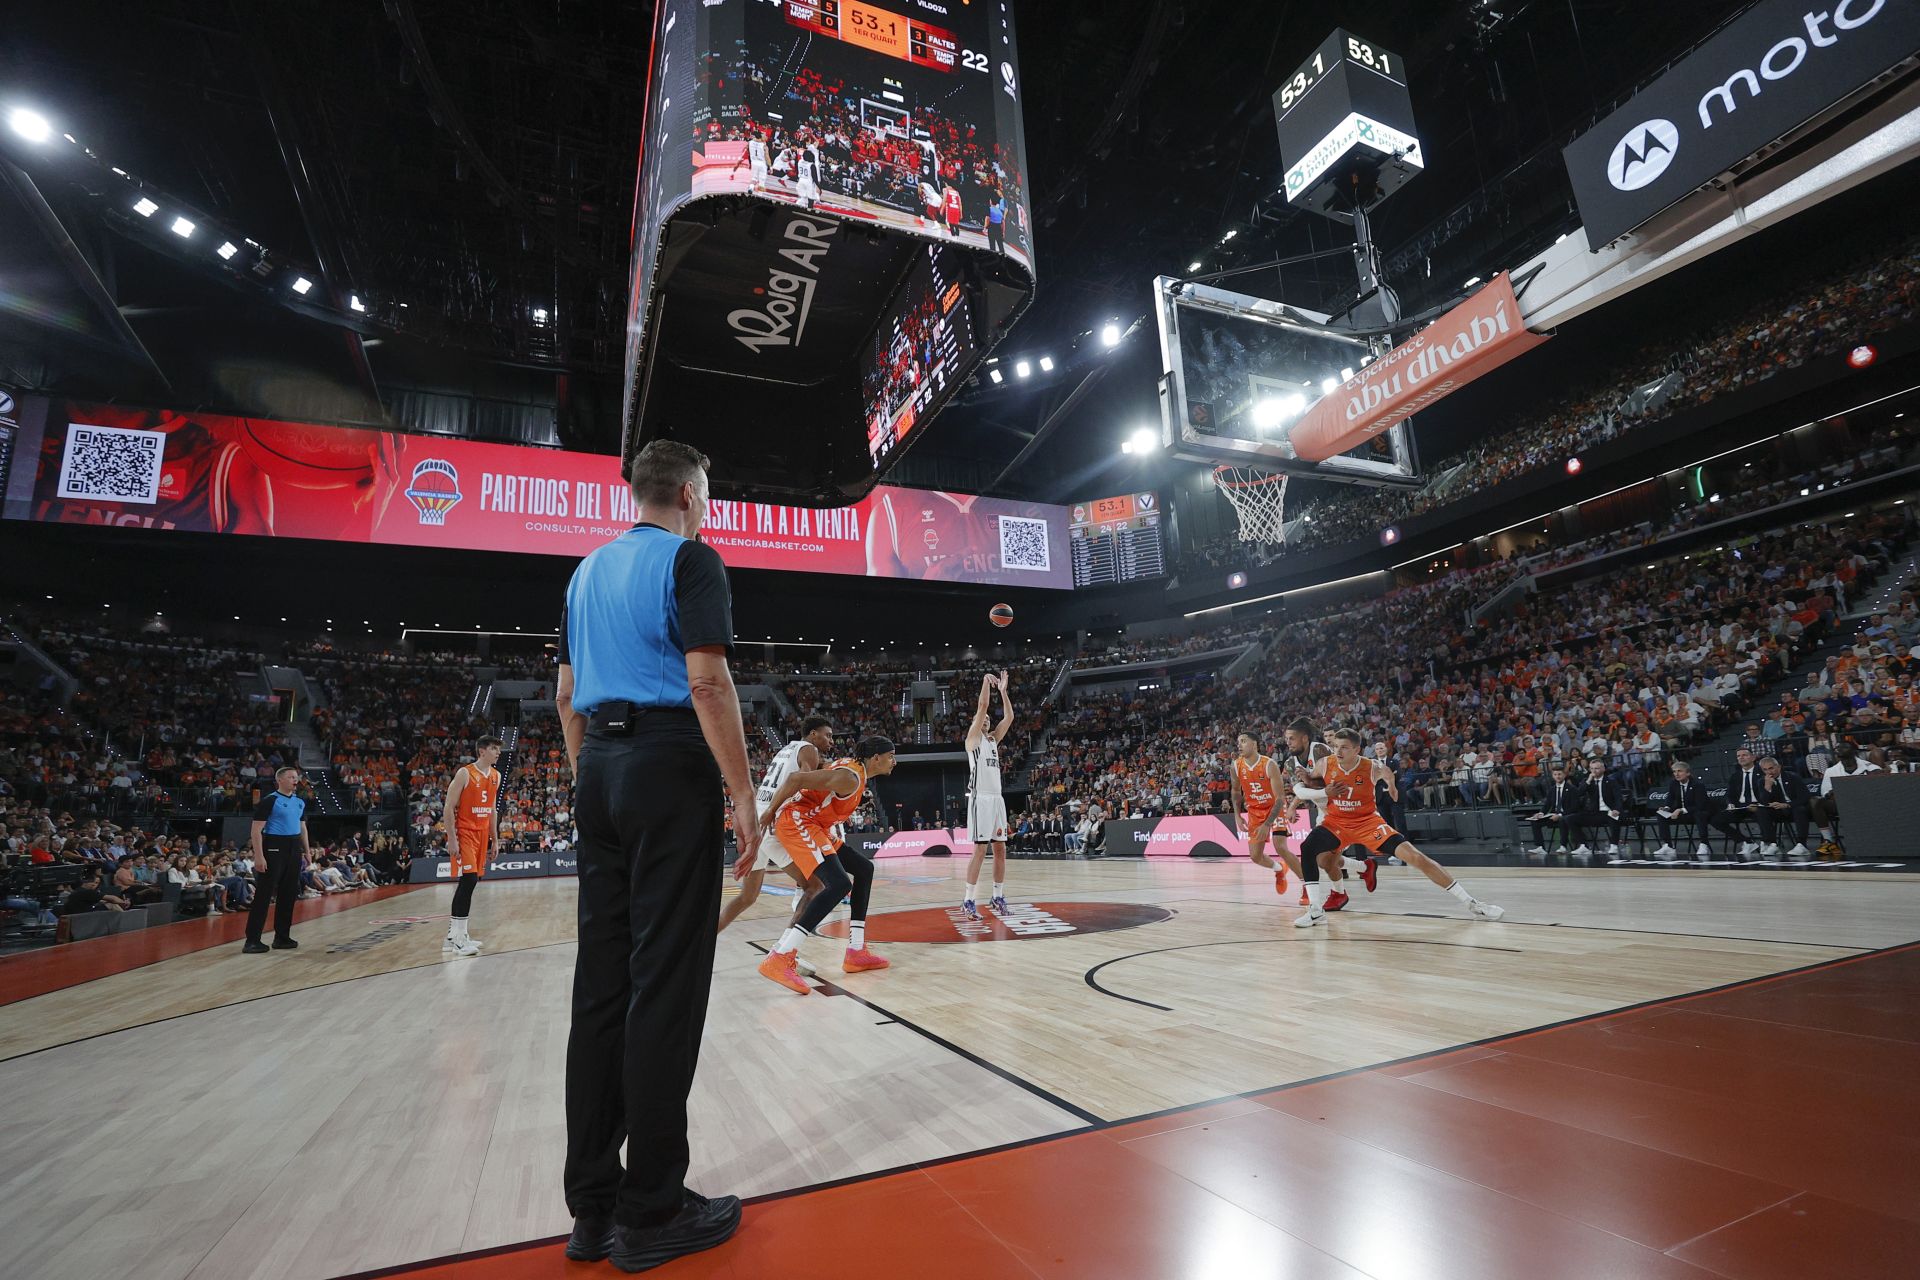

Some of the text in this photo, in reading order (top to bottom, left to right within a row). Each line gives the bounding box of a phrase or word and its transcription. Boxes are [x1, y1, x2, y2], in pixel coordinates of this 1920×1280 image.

[790, 3, 814, 16] TEMPS
[790, 10, 812, 21] MORT
[825, 2, 833, 12] 5
[826, 17, 833, 27] 0
[851, 9, 896, 36] 53.1
[853, 27, 898, 46] 1ER QUART
[915, 30, 956, 50] 3 FALTES
[916, 45, 955, 62] 1 TEMPS
[936, 56, 955, 66] MORT
[961, 49, 989, 73] 22
[1348, 37, 1391, 74] 53.1
[1281, 53, 1324, 109] 53.1
[1305, 138, 1337, 168] caixa
[1307, 129, 1356, 178] popular
[778, 211, 841, 273] AR
[1346, 335, 1425, 390] experience
[1345, 373, 1403, 421] abu
[409, 490, 438, 498] VALENCIA
[480, 472, 569, 518] PARTIDOS
[575, 481, 602, 520] DEL
[702, 498, 747, 532] ASKET
[755, 503, 773, 534] YA
[778, 505, 788, 536] A
[793, 506, 810, 537] LA
[815, 507, 860, 541] VENTA
[1099, 499, 1126, 512] 53.1
[1101, 525, 1113, 534] 24
[1116, 521, 1128, 531] 22
[525, 521, 586, 535] CONSULTA
[590, 526, 626, 538] PRÓXI
[711, 536, 824, 552] VALENCIABASKET.COM
[481, 790, 488, 803] 5
[862, 840, 926, 851] Find your pace
[1133, 831, 1192, 844] Find your pace
[490, 860, 541, 871] KGM
